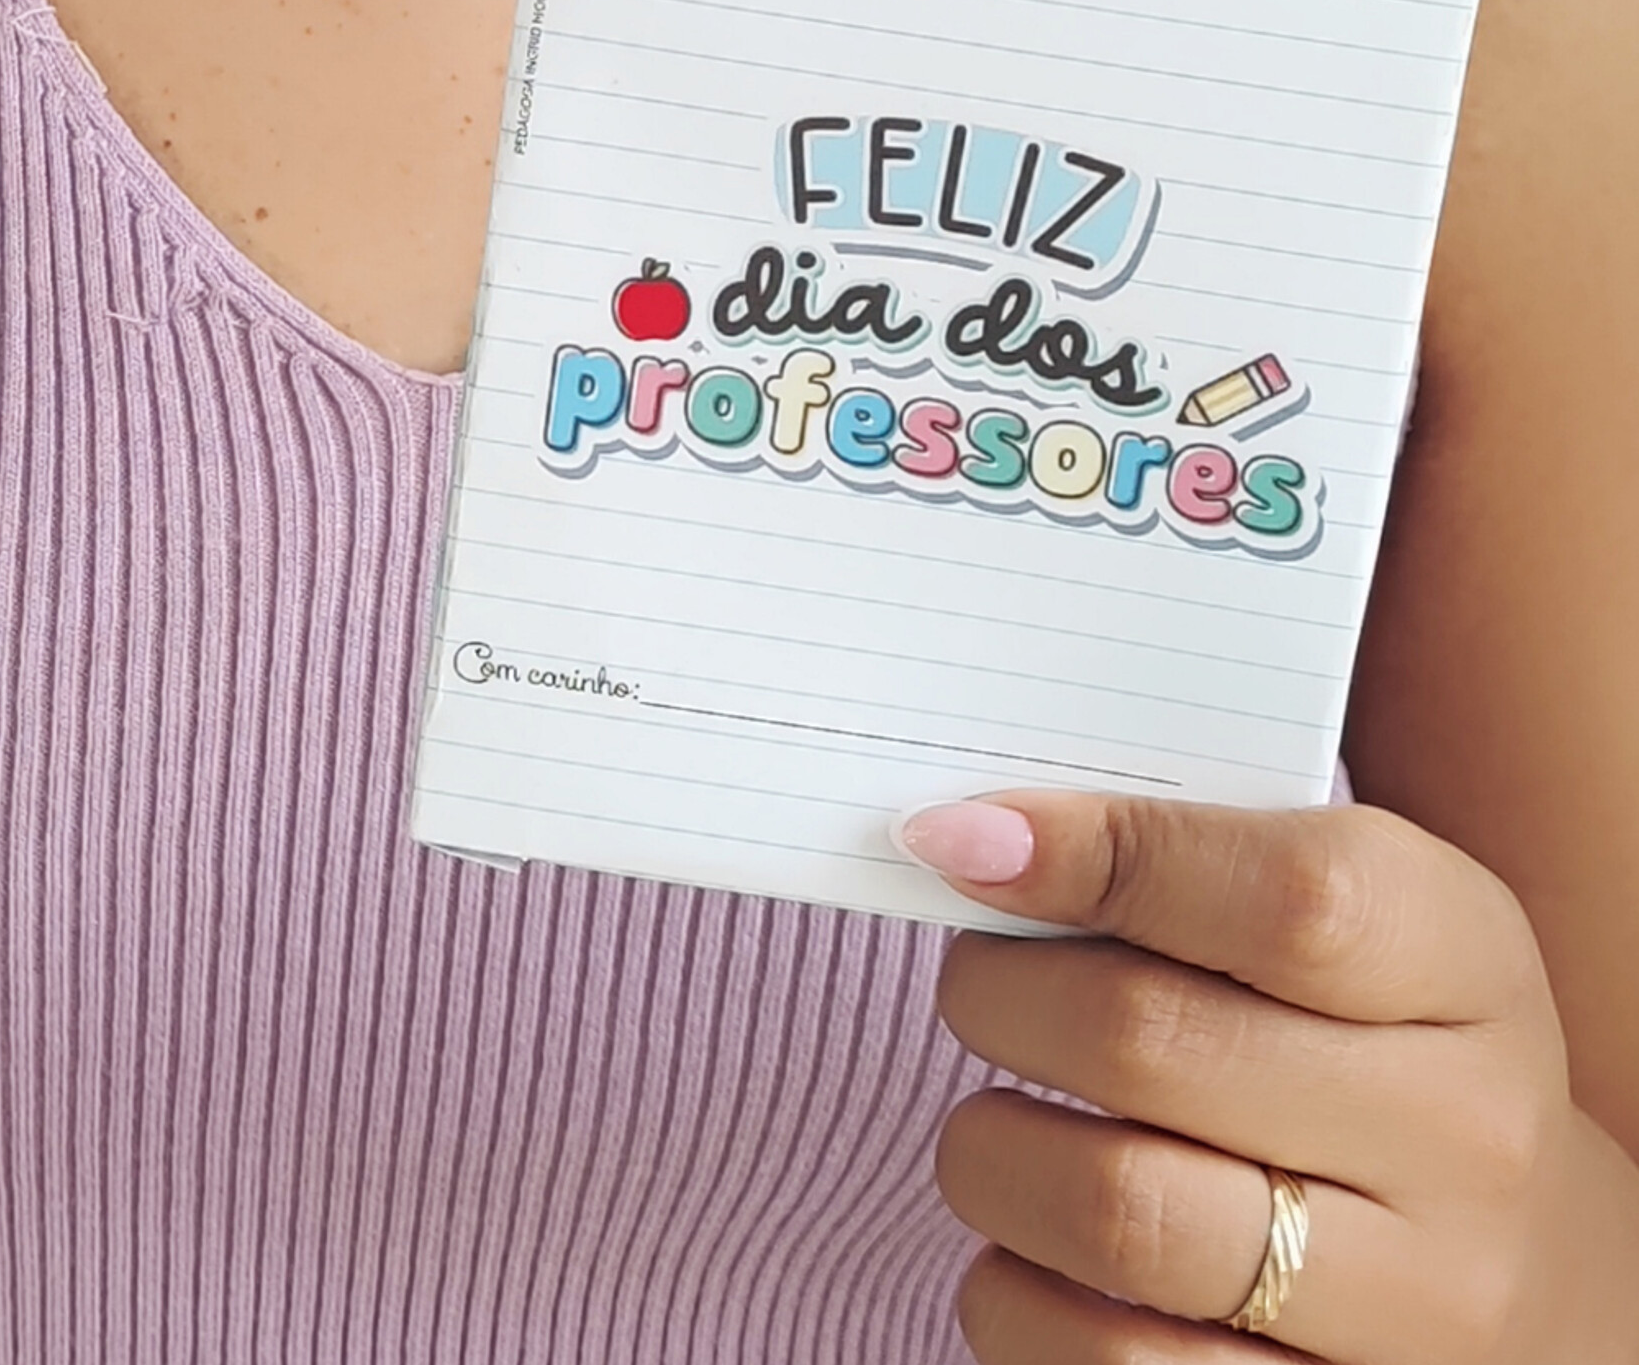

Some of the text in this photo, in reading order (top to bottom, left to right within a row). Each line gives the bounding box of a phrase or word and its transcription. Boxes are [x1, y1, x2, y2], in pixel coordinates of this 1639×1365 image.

[514, 80, 535, 156] PEDAGOGA
[525, 28, 543, 76] INGRID
[789, 116, 1126, 271] FELIZ
[712, 245, 1162, 407] dia dos
[543, 344, 1307, 536] professores
[453, 642, 641, 701] Com carinho:
